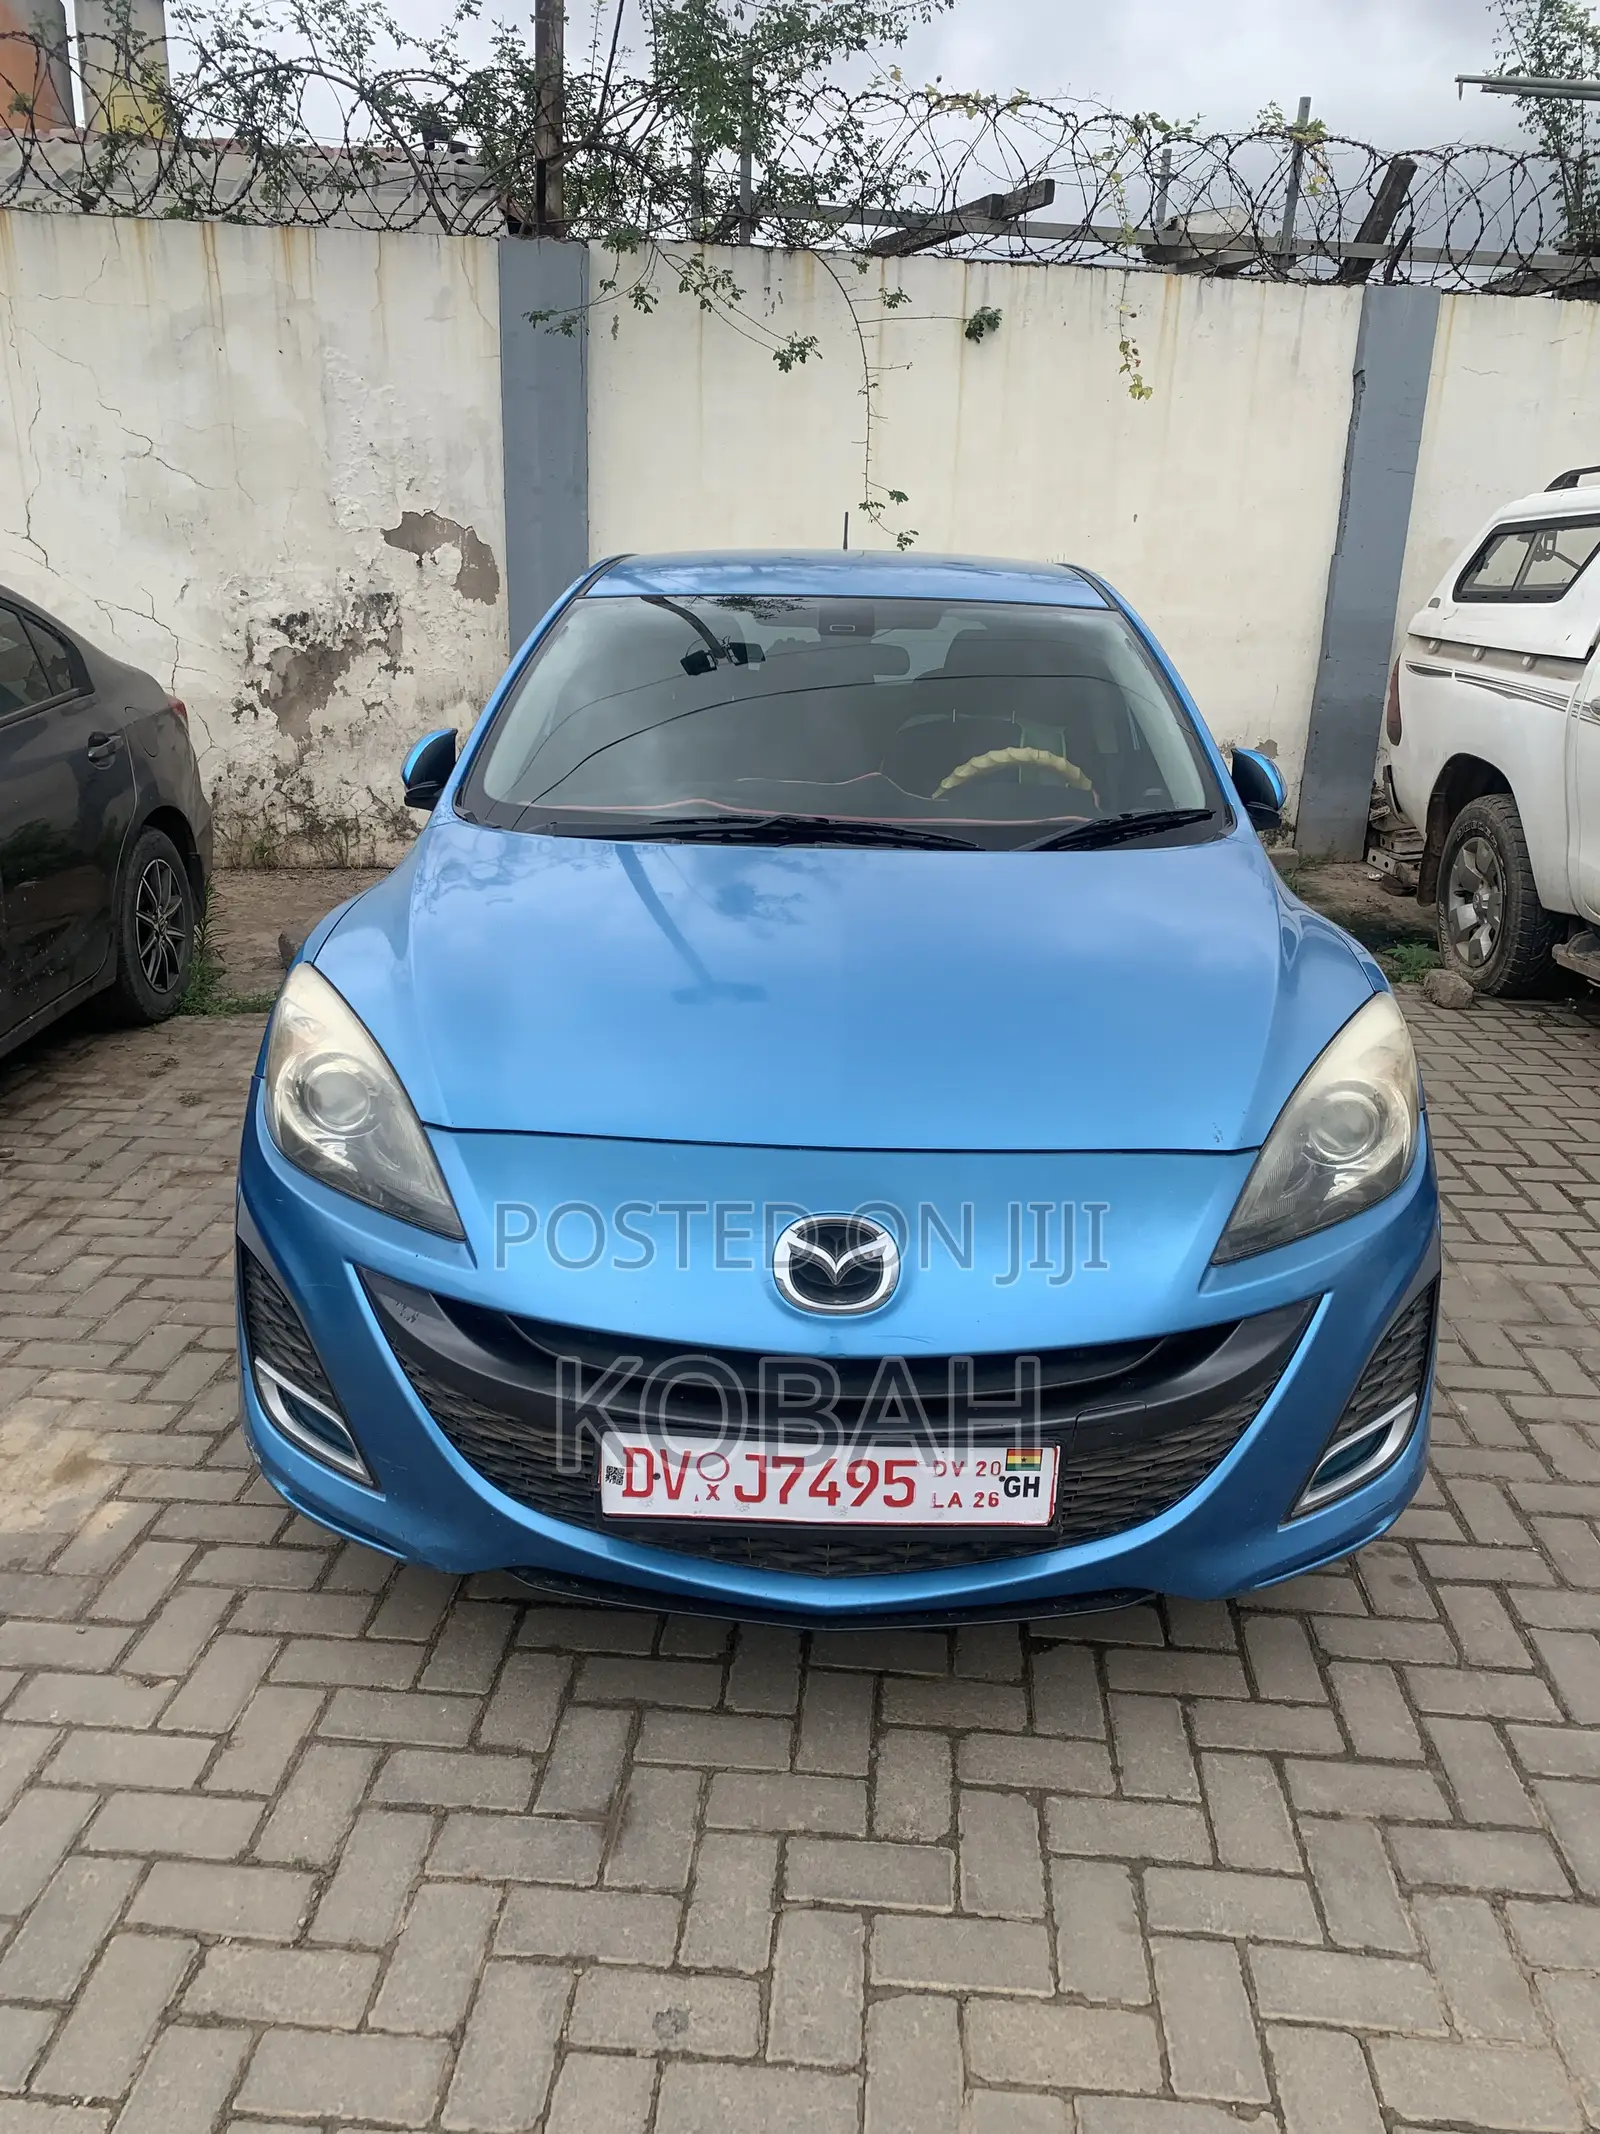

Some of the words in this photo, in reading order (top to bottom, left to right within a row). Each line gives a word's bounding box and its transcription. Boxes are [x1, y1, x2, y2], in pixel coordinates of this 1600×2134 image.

[622, 1446, 692, 1500] DV
[734, 1454, 918, 1508] J7495
[933, 1460, 965, 1477] DV
[975, 1460, 1002, 1477] 20
[1003, 1475, 1041, 1498] GH
[931, 1492, 963, 1509] LA
[973, 1491, 1000, 1508] 26
